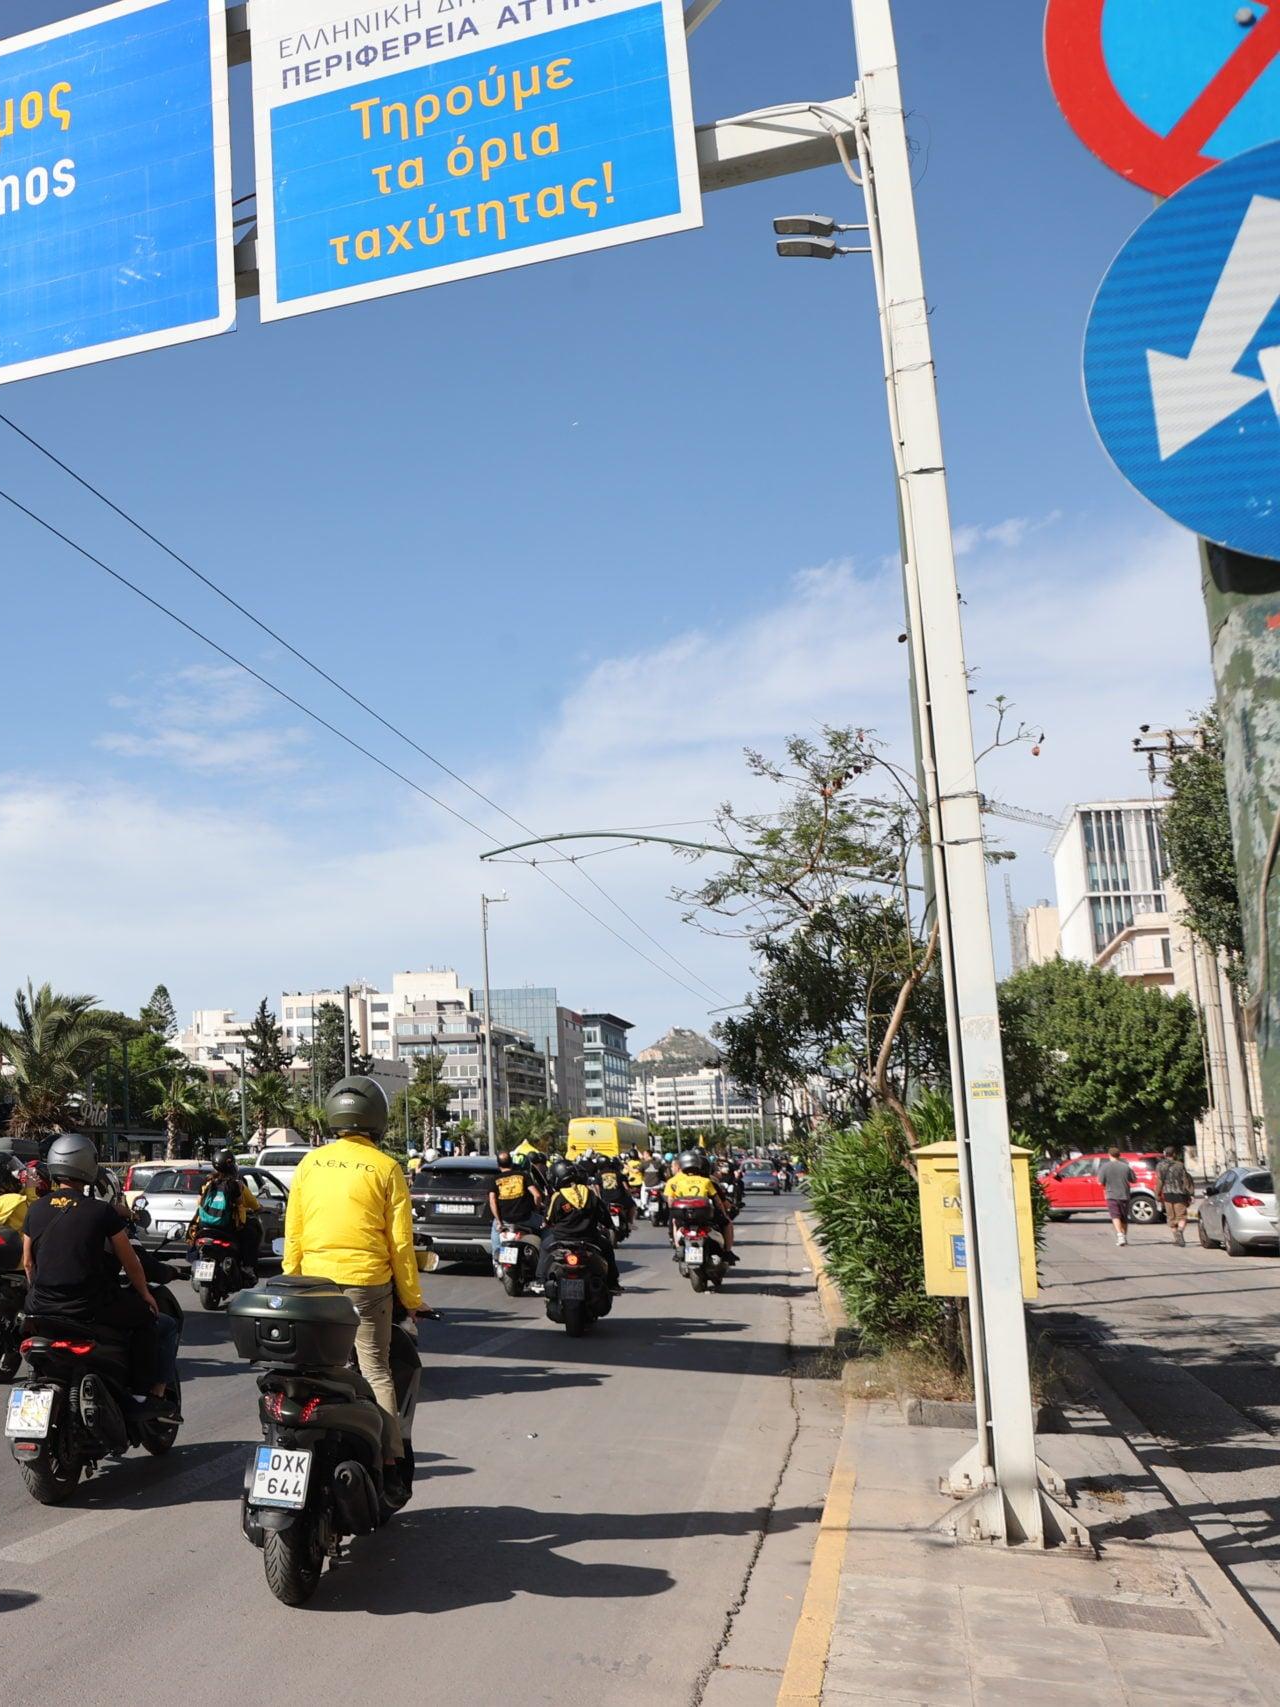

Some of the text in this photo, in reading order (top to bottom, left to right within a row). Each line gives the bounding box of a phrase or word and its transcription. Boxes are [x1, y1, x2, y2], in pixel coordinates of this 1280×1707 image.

[280, 0, 422, 59] ΕΛΛΗΝΙΚΗ
[282, 18, 479, 89] ΠΕΡΙΦΕΡΕΙΑ
[350, 57, 575, 141] Τηρούμε
[372, 123, 560, 195] τα όρια
[329, 161, 616, 266] ταχύτητας!
[267, 1478, 302, 1497] 644
[271, 1455, 306, 1474] OXK
